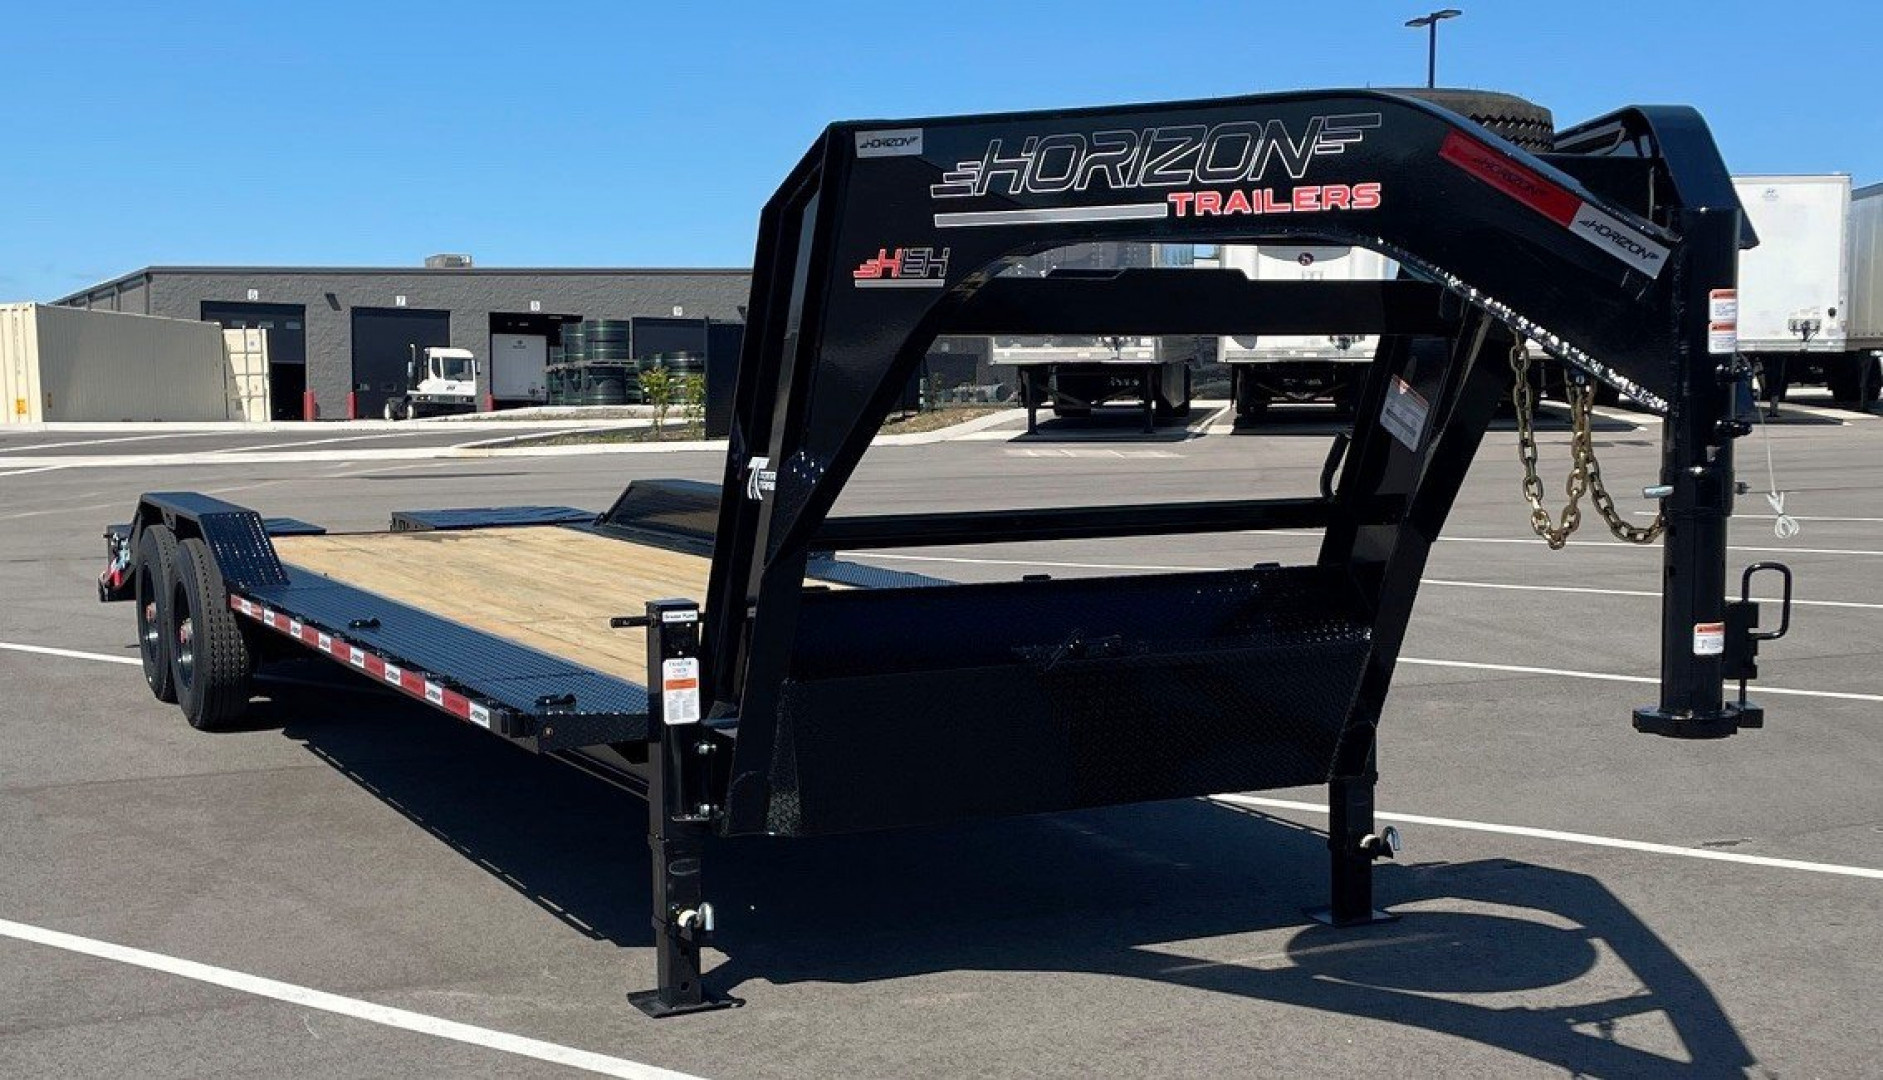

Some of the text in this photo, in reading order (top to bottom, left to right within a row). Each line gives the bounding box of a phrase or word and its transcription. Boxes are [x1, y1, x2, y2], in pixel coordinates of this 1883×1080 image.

[968, 114, 1330, 197] HORIZON
[1168, 182, 1381, 217] TRAILERS
[1584, 219, 1655, 260] HORIZON
